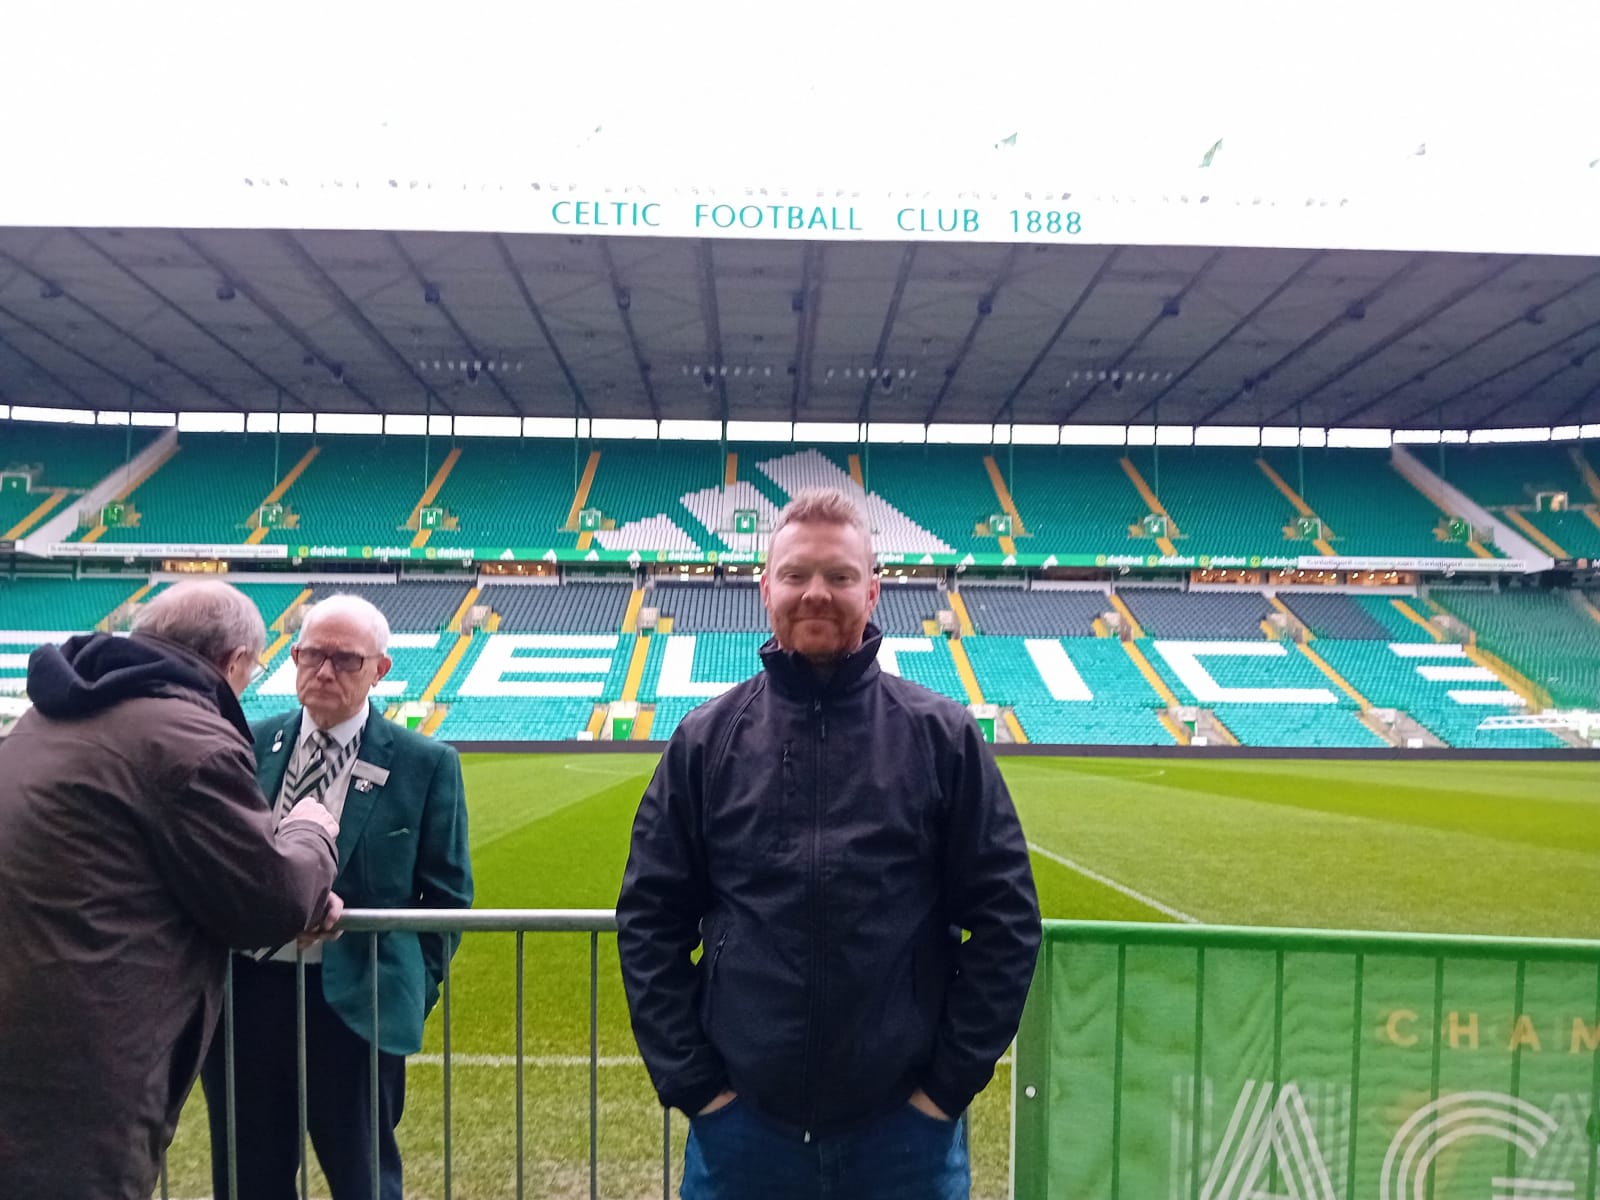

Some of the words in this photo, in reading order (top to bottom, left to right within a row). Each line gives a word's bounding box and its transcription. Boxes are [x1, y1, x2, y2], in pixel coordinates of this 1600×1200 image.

[551, 201, 662, 227] CELTIC
[695, 204, 864, 232] FOOTBALL
[897, 208, 980, 234] CLUB
[1011, 210, 1083, 235] 1888
[310, 546, 348, 558] dafabet
[373, 546, 411, 558] dafabet
[437, 547, 475, 559] dafabet
[1106, 554, 1143, 566] dafabet
[1157, 554, 1195, 567] dafabet
[1209, 555, 1246, 567] dafabet
